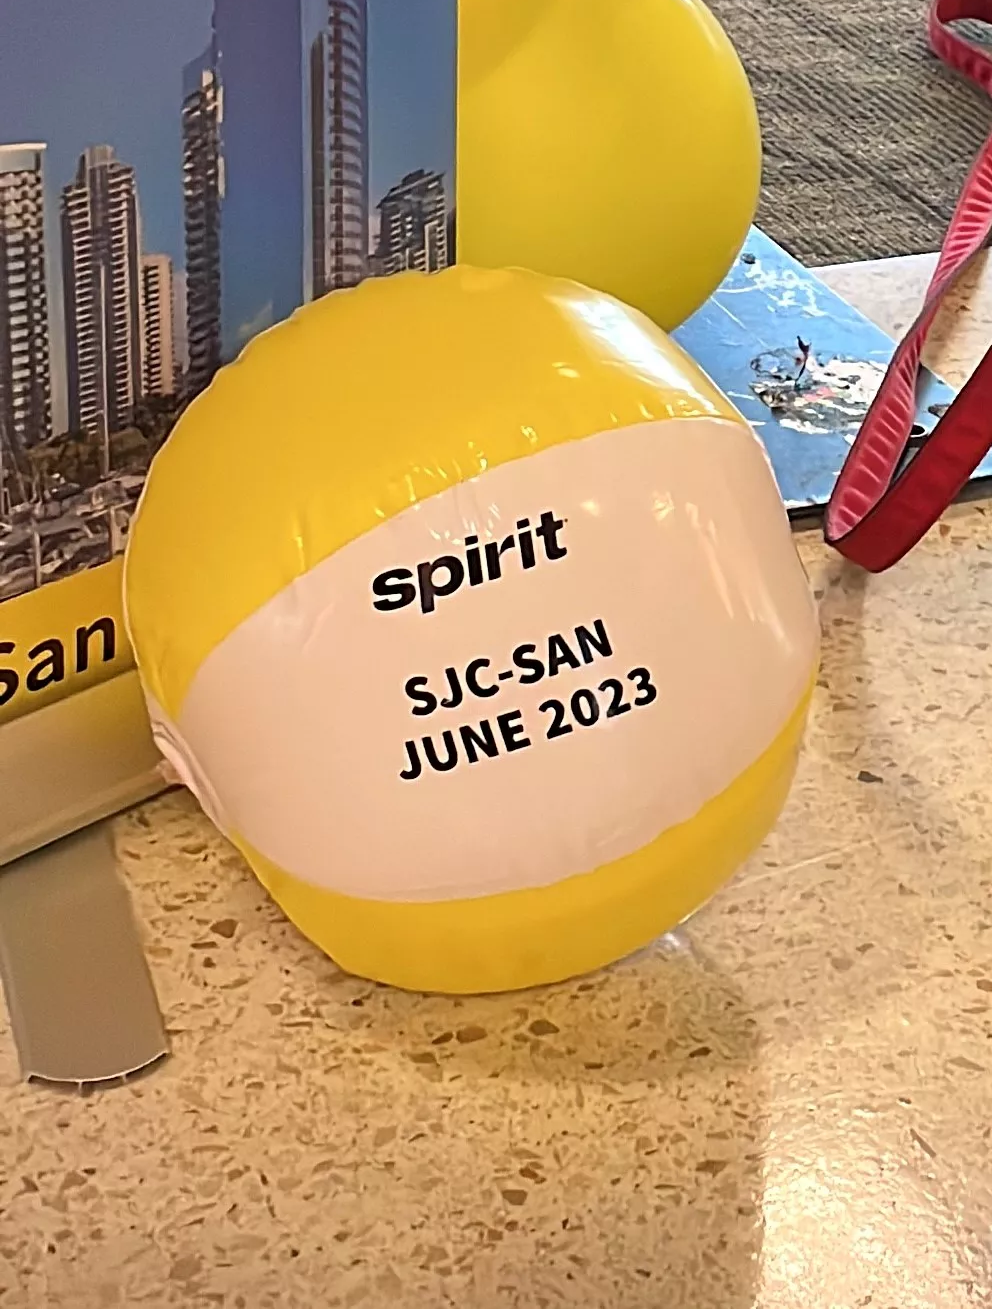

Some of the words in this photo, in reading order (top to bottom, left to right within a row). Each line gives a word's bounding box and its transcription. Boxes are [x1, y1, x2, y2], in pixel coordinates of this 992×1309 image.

[372, 511, 568, 614] spirit
[404, 618, 614, 716] SJC-SAN
[399, 709, 532, 780] JUNE
[538, 666, 658, 740] 2023
